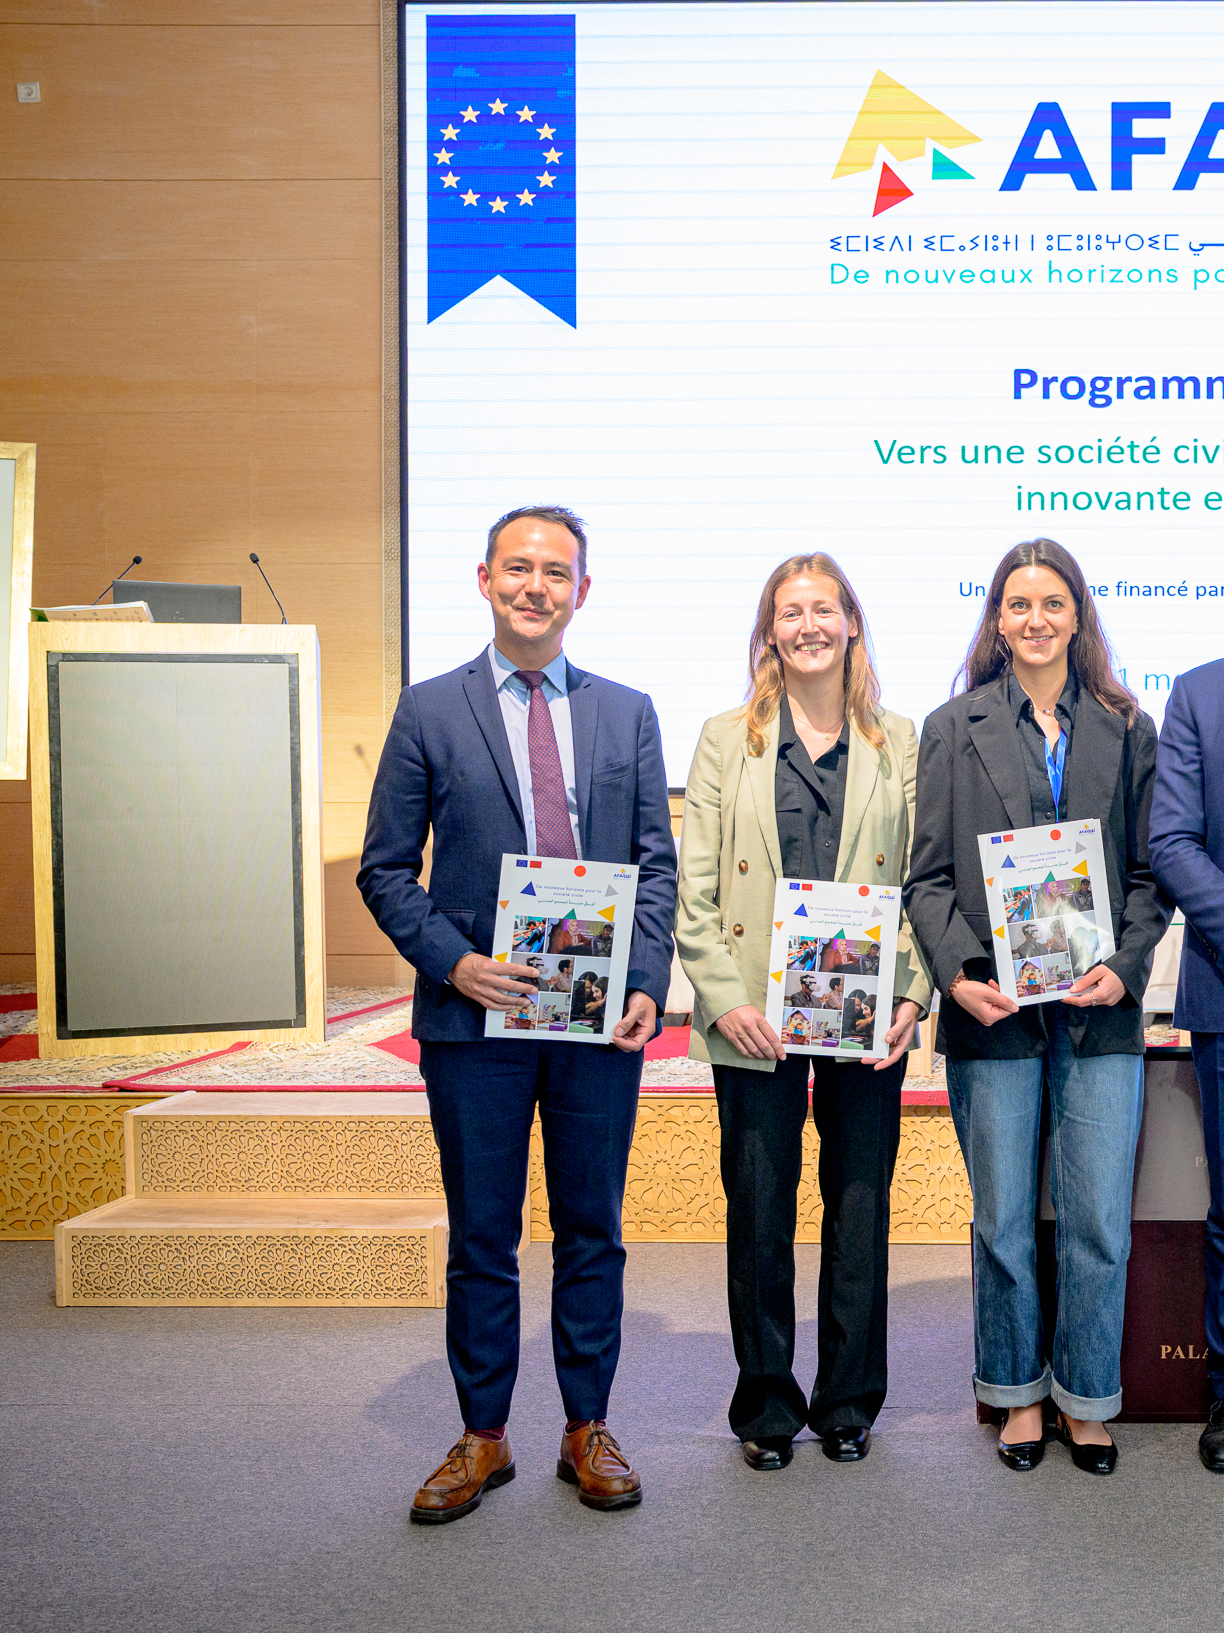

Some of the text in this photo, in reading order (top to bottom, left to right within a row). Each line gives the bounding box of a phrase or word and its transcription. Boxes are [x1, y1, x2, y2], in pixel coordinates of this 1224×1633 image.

[830, 263, 870, 284] De
[886, 268, 1033, 284] nouveaux
[1048, 260, 1179, 284] horizons
[874, 440, 948, 465] Vers
[960, 445, 1025, 465] une
[1037, 436, 1161, 465] société
[1016, 486, 1192, 511] innovante
[959, 582, 986, 597] Un
[1116, 580, 1189, 597] financé
[1160, 1344, 1209, 1359] PALA
